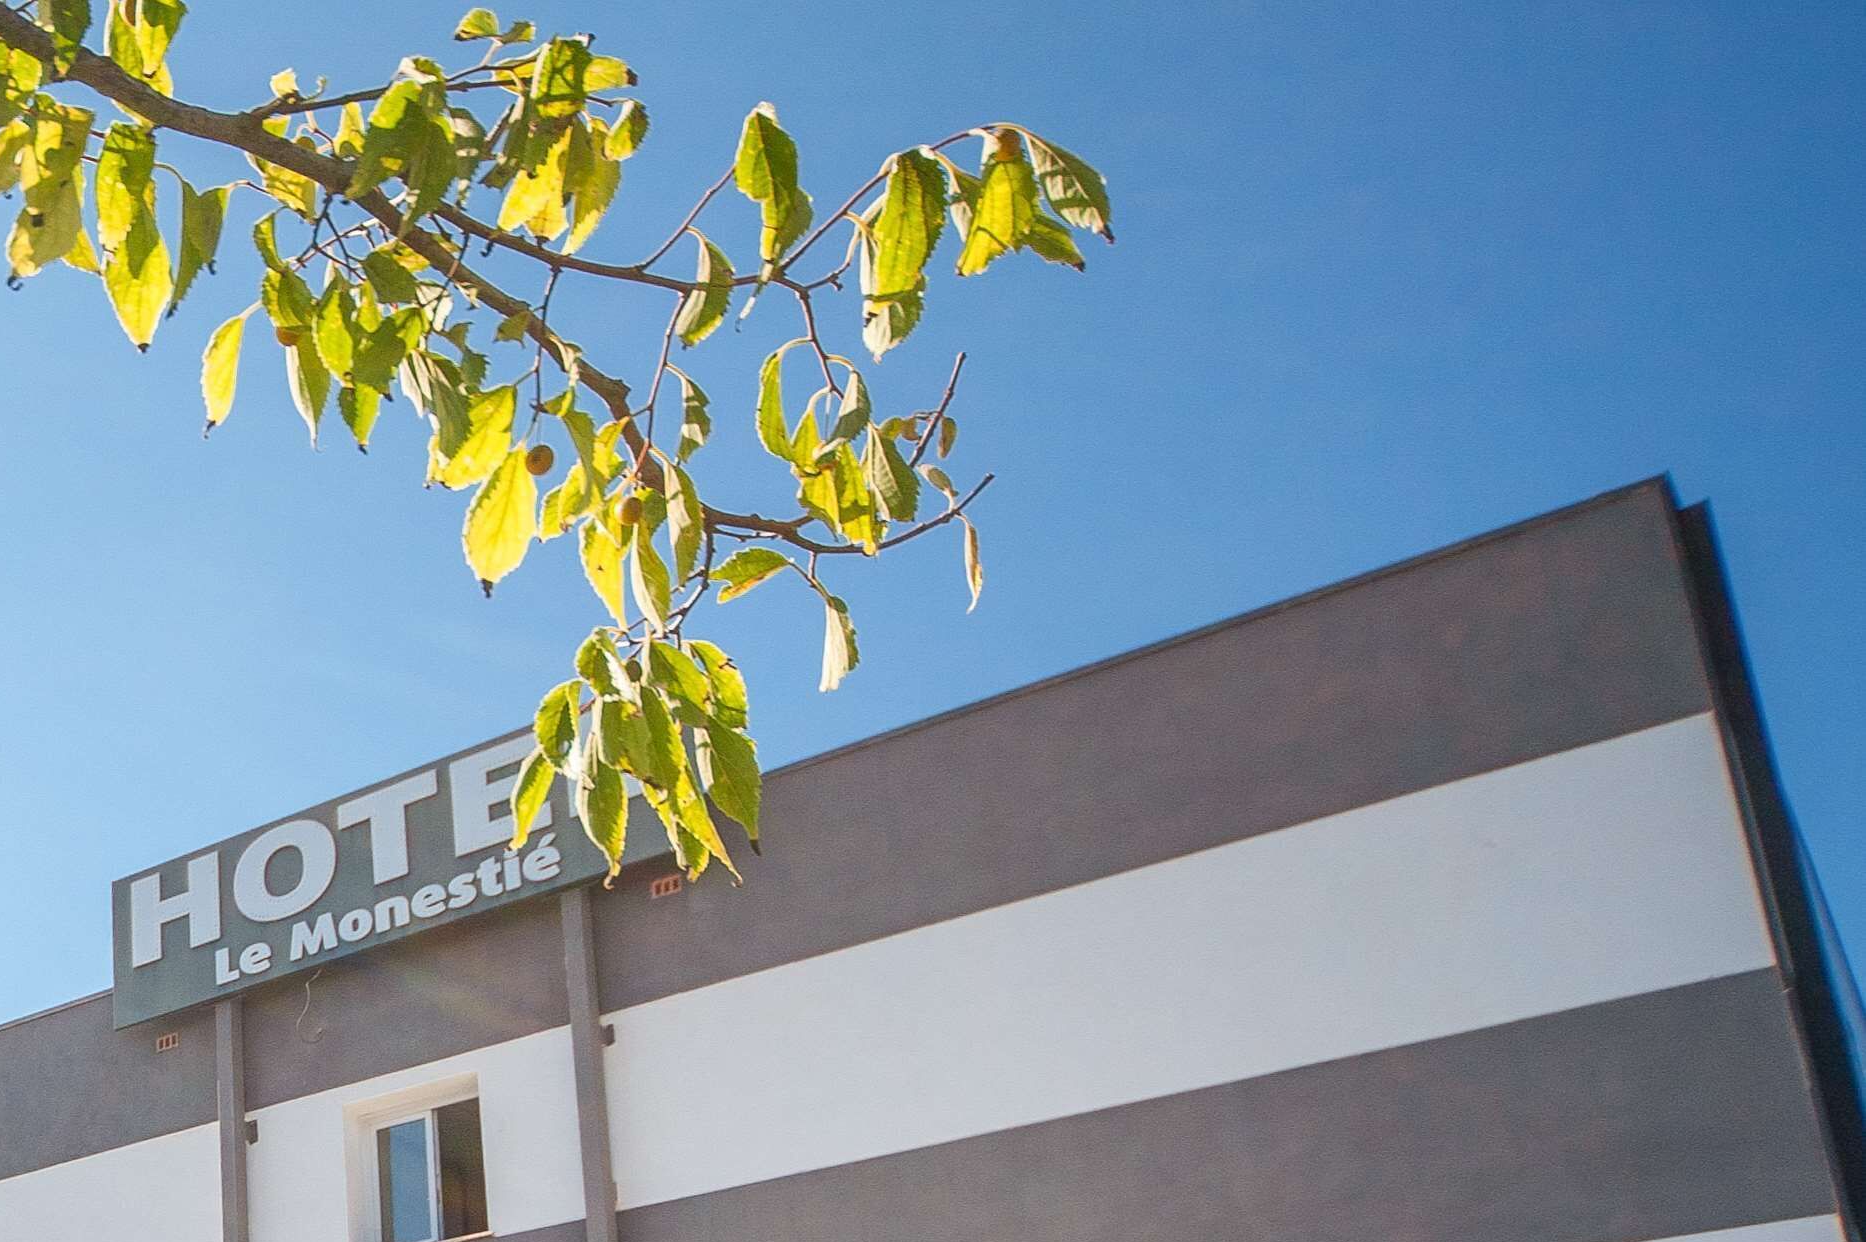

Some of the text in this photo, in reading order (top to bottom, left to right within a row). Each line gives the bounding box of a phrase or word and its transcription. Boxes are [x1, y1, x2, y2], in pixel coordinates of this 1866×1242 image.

[131, 714, 643, 969] HOTE
[214, 832, 562, 986] Le Monestié
